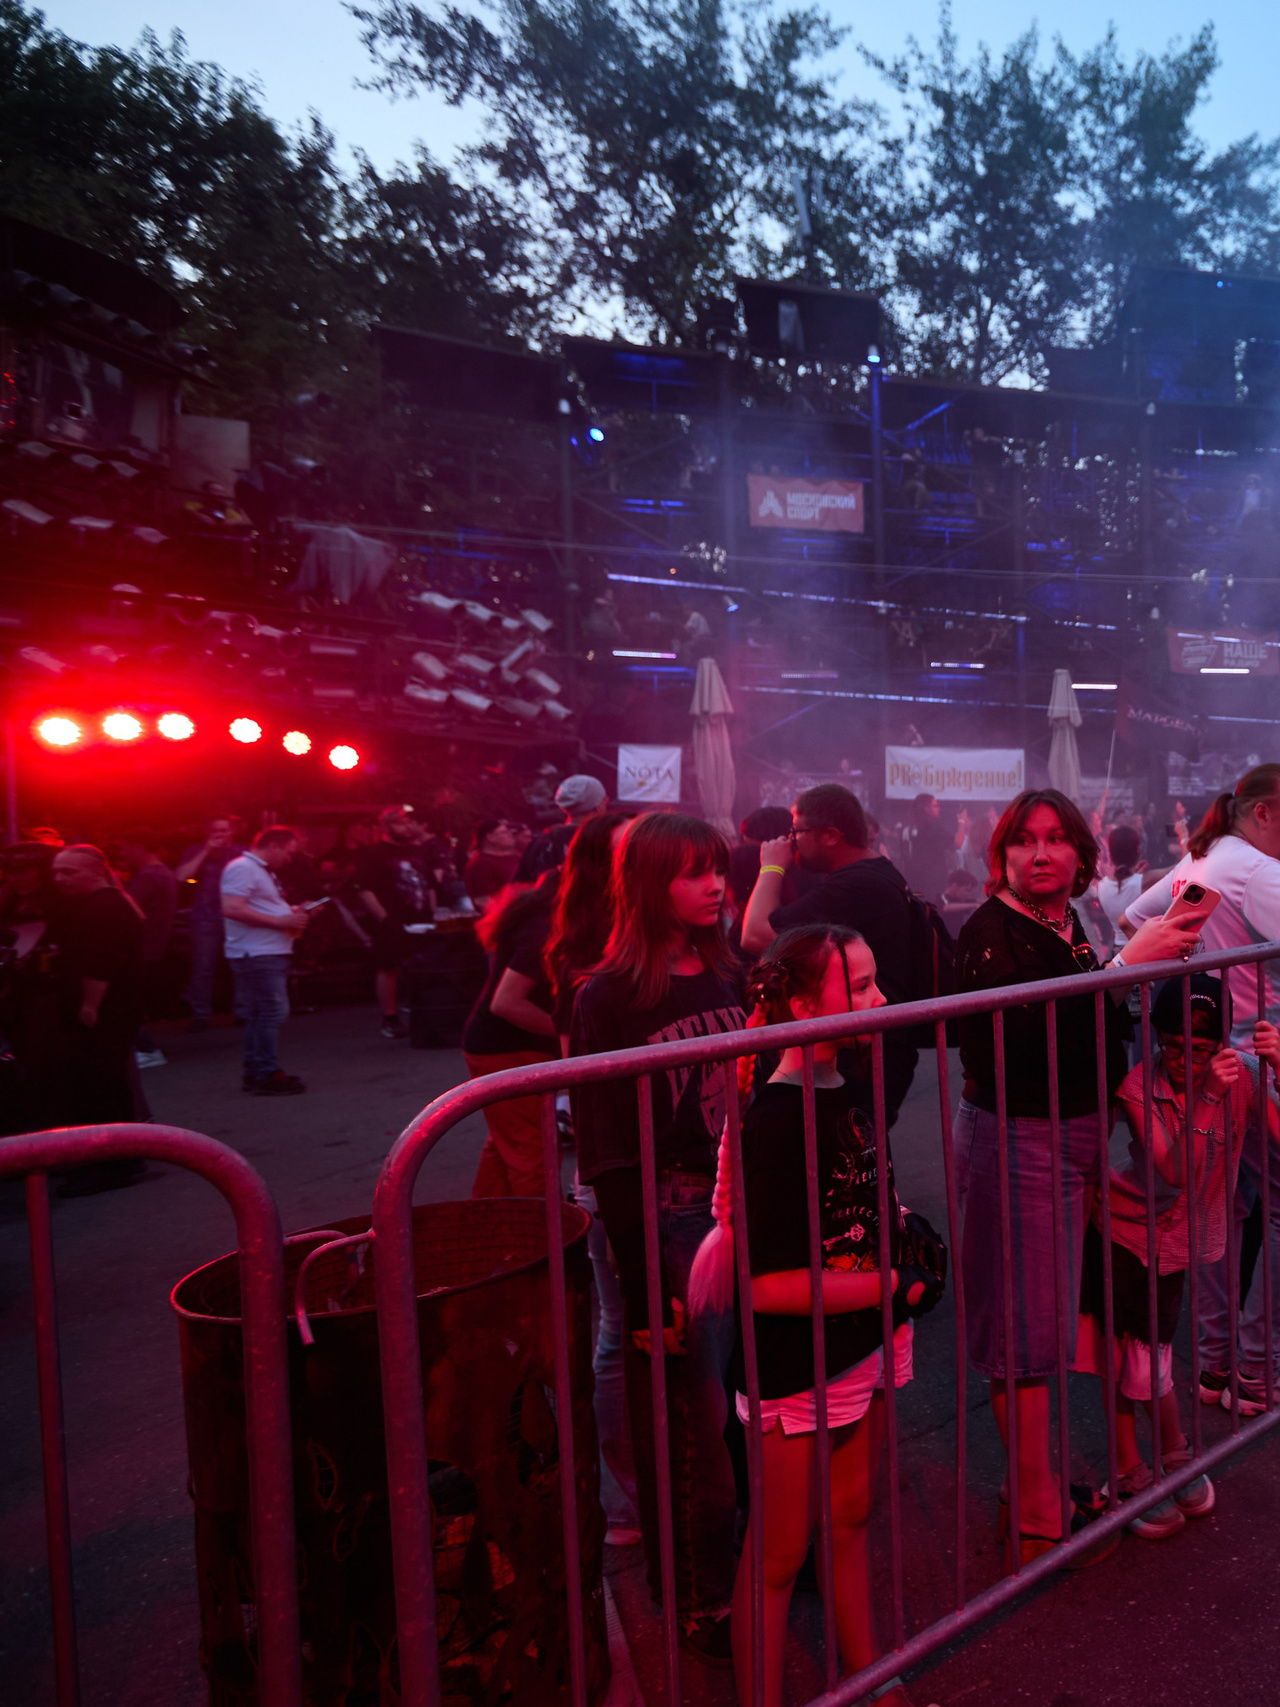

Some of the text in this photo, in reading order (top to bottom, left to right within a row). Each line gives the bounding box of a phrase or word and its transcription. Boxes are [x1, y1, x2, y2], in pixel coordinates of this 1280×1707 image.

[786, 492, 856, 509] МОСКОВСКИЙ
[787, 507, 820, 520] СПОРТ
[1223, 641, 1268, 659] НАШЕ
[1223, 658, 1260, 668] РАДИО
